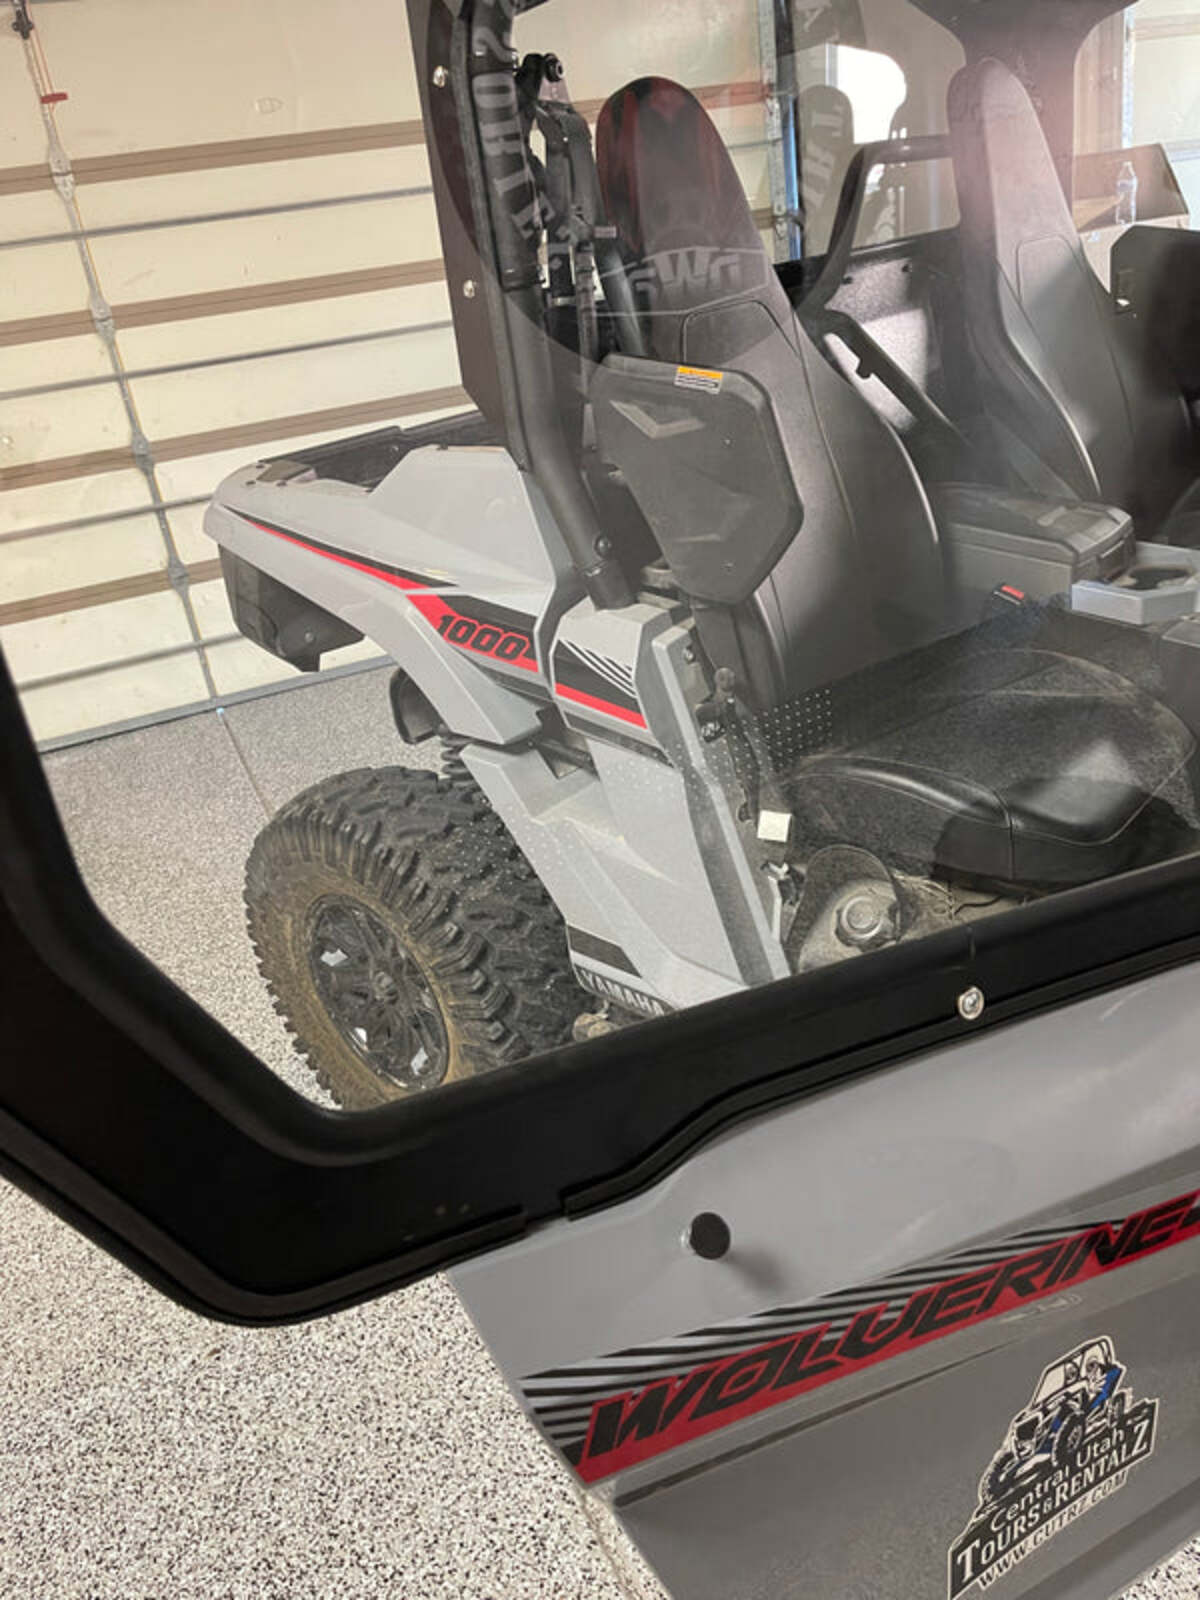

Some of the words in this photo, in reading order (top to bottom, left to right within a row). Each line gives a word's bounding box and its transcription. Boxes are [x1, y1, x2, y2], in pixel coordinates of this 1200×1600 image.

[437, 613, 527, 661] 1000
[580, 969, 665, 1017] YAMAHA
[990, 1464, 1071, 1532] Central
[1076, 1428, 1125, 1468] Utah
